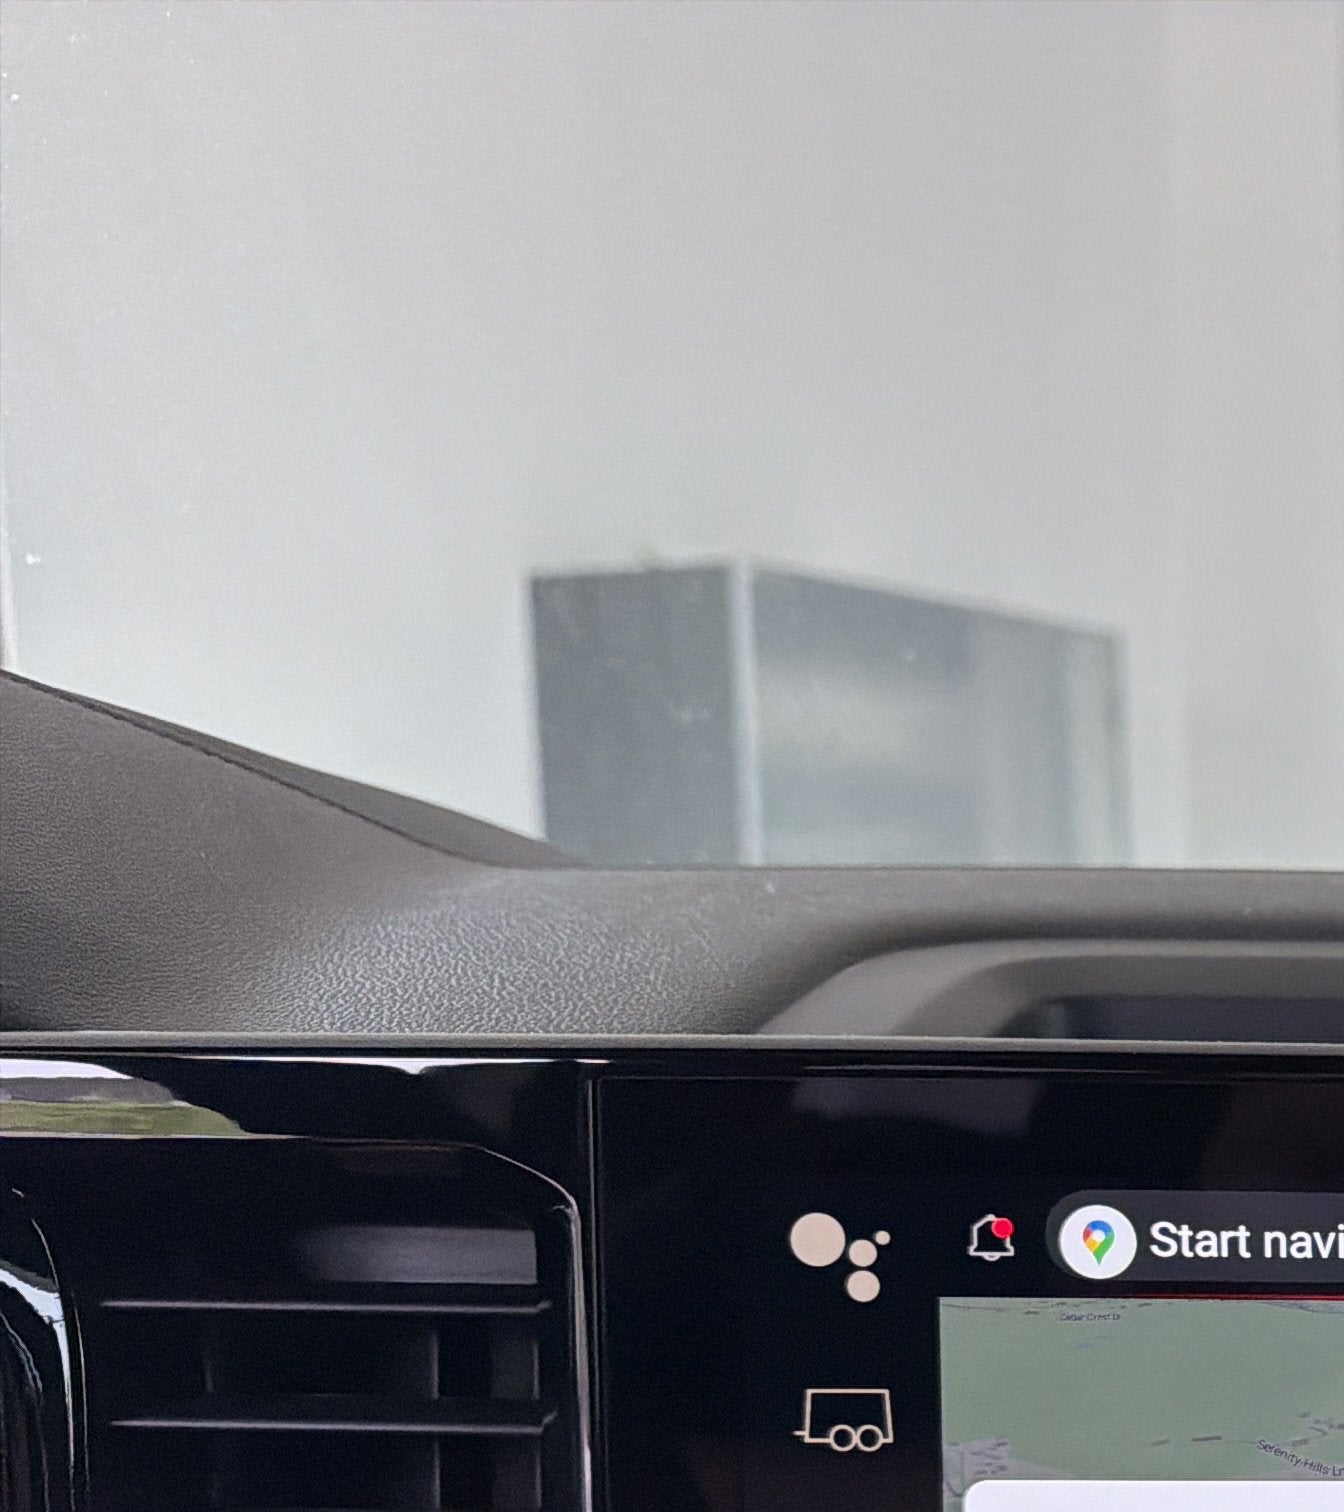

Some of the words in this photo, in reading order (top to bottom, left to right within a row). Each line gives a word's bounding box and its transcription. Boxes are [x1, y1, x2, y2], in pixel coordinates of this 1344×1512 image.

[1150, 1221, 1251, 1259] Start
[1257, 1439, 1301, 1466] Serenity
[1303, 1459, 1329, 1475] Hills
